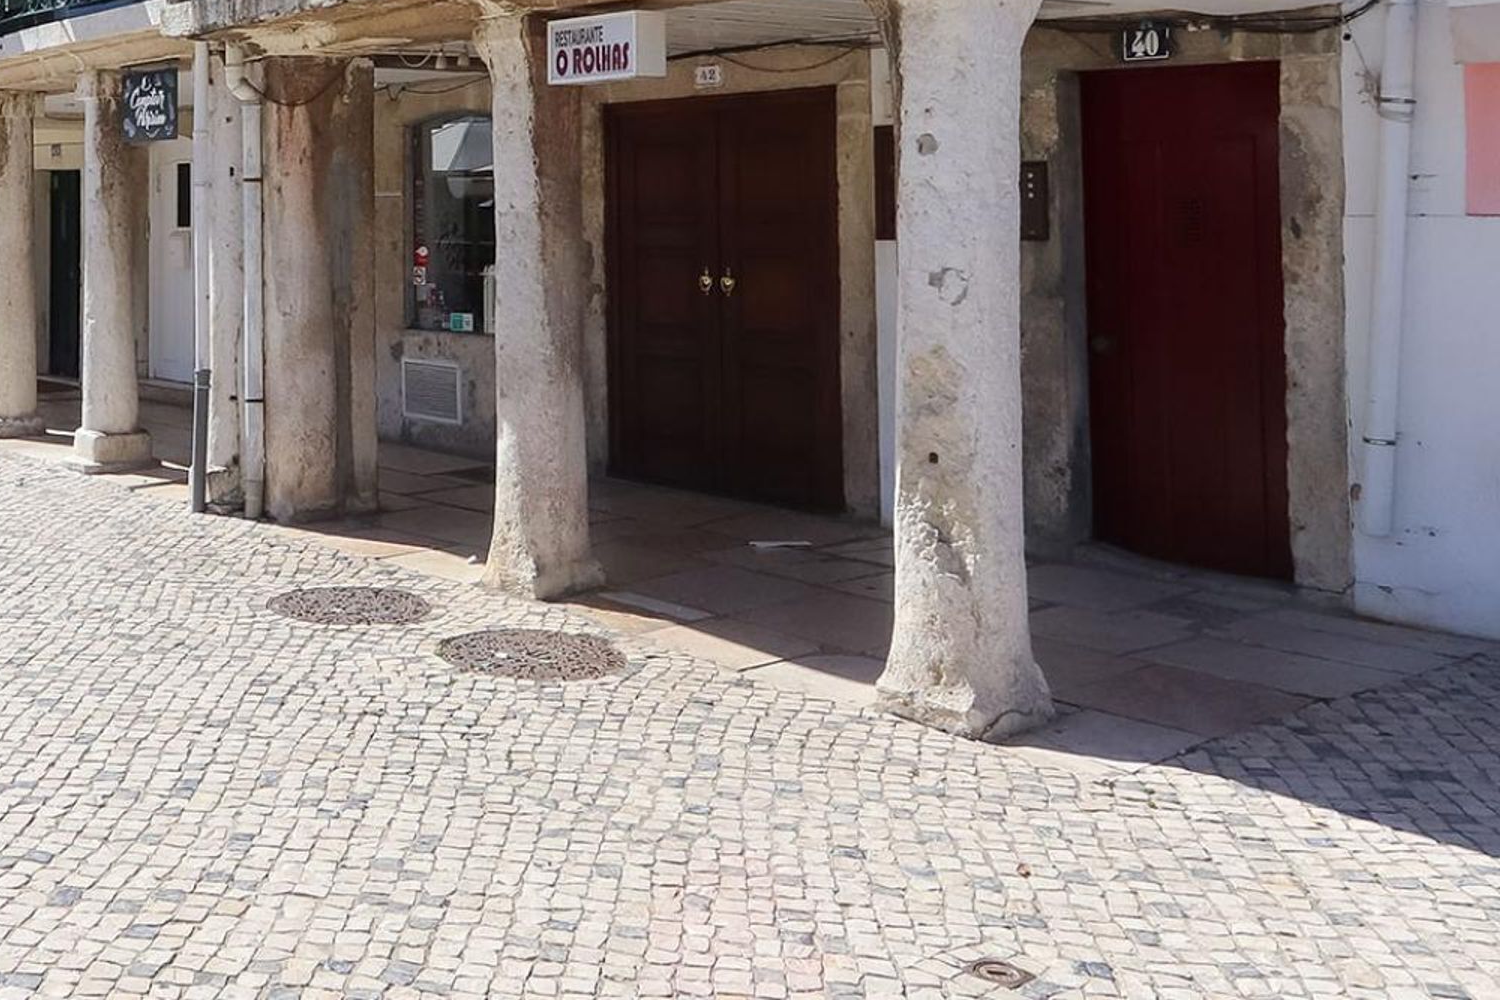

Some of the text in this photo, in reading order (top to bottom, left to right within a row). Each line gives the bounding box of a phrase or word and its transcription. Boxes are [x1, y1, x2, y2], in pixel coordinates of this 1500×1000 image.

[555, 26, 603, 47] RESTAURANTE
[1131, 30, 1159, 56] 40
[556, 42, 629, 76] O ROLHAS
